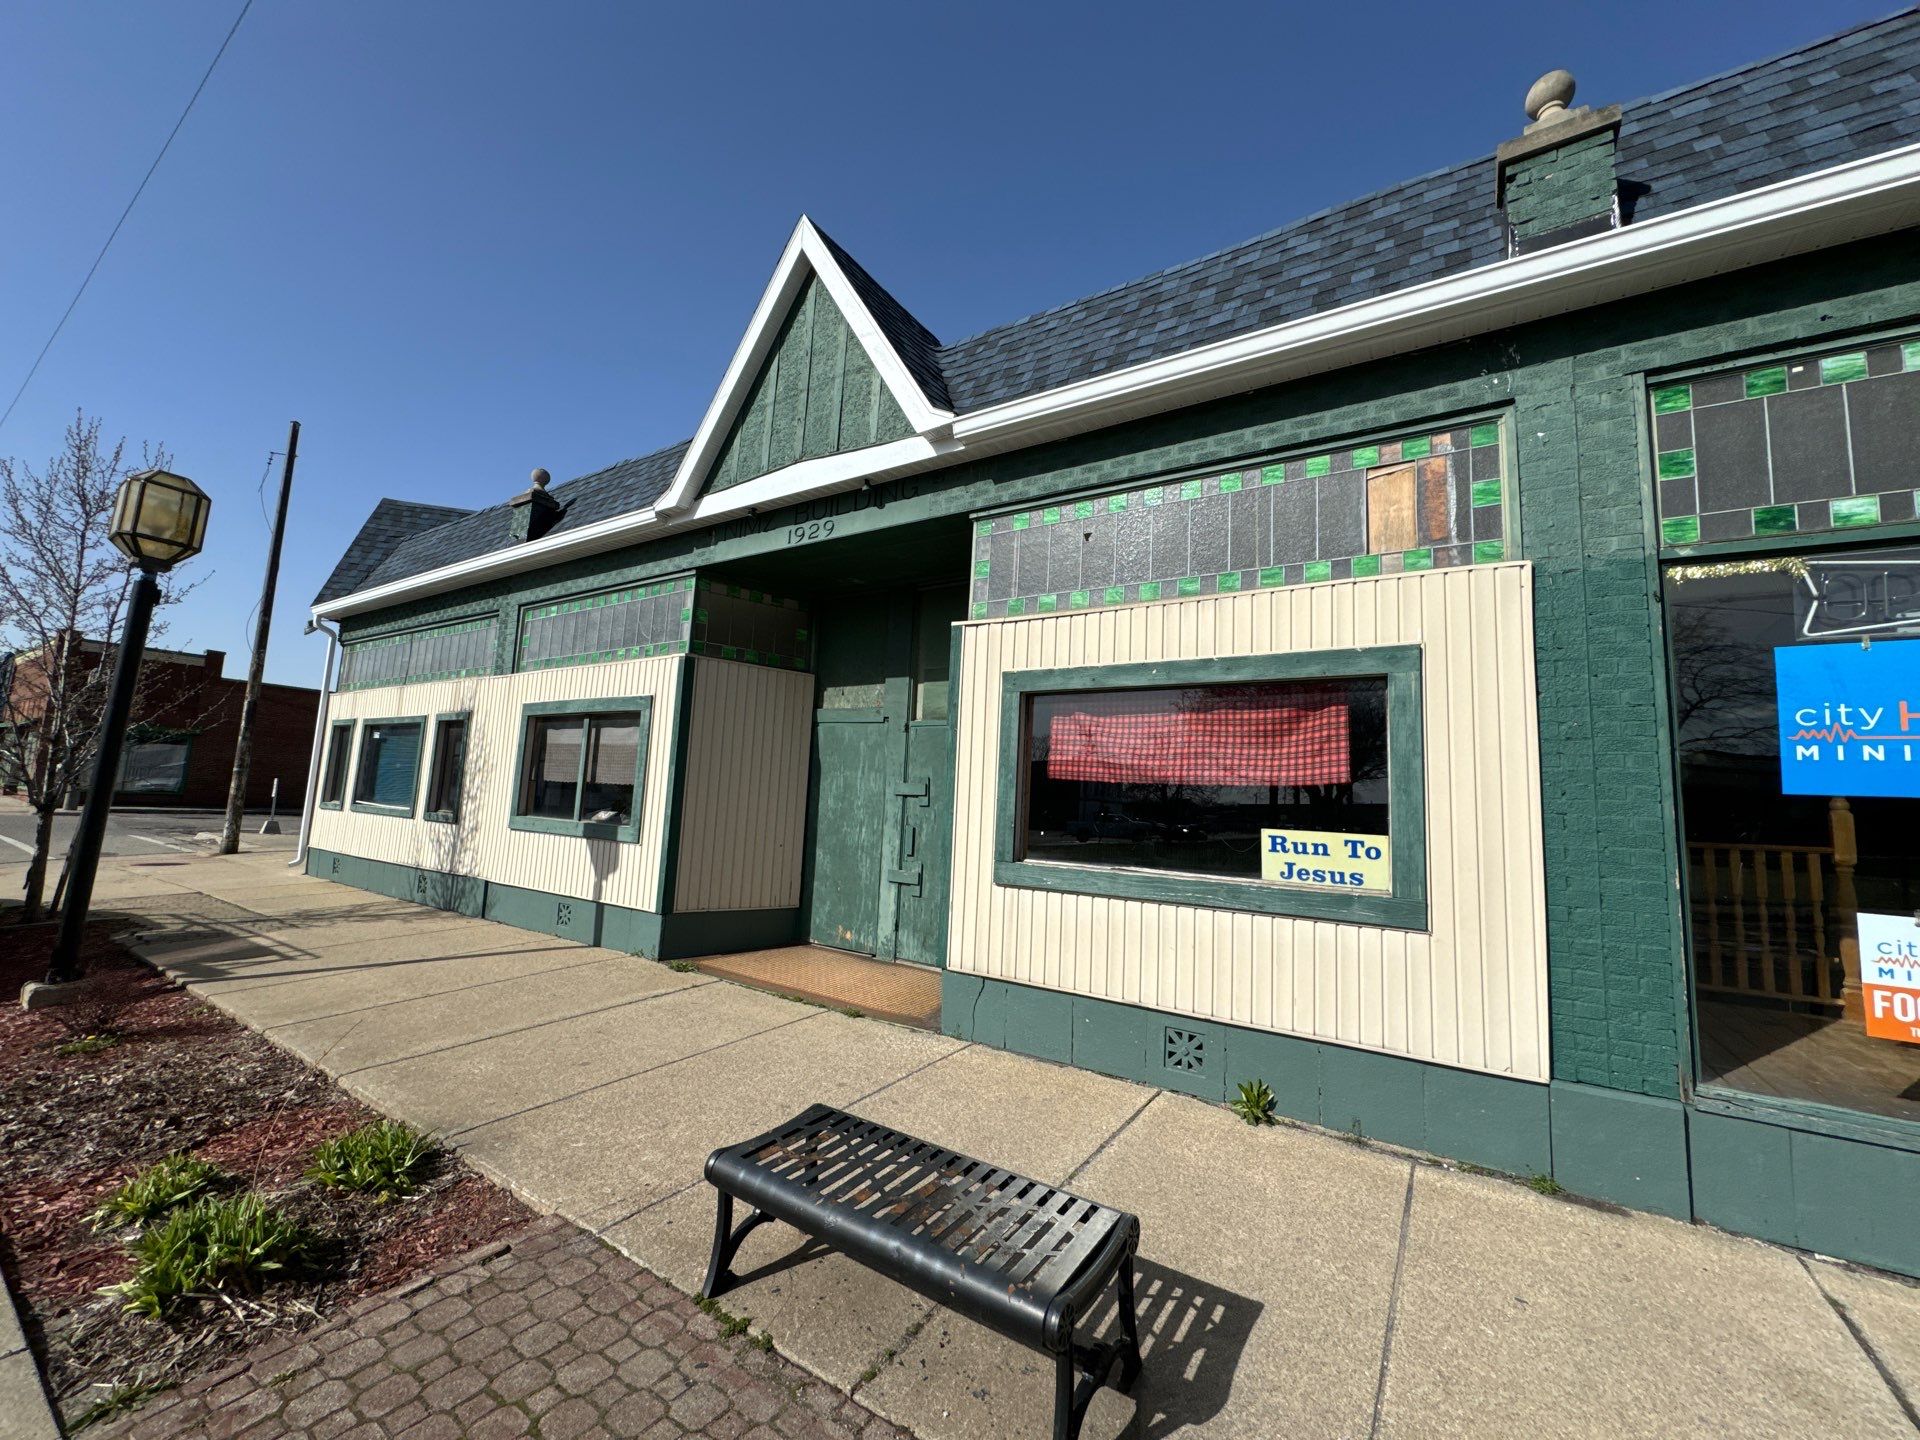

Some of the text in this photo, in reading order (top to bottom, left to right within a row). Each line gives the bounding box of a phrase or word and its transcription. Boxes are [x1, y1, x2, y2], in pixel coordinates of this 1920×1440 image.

[795, 478, 919, 525] BUILDING
[788, 520, 835, 544] 1929
[1795, 702, 1884, 730] city
[1796, 744, 1911, 761] MINI
[1268, 835, 1382, 860] Run To
[1280, 862, 1365, 887] Jesus
[1877, 940, 1919, 958] cit
[1878, 966, 1912, 982] MI
[1873, 989, 1920, 1024] FO
